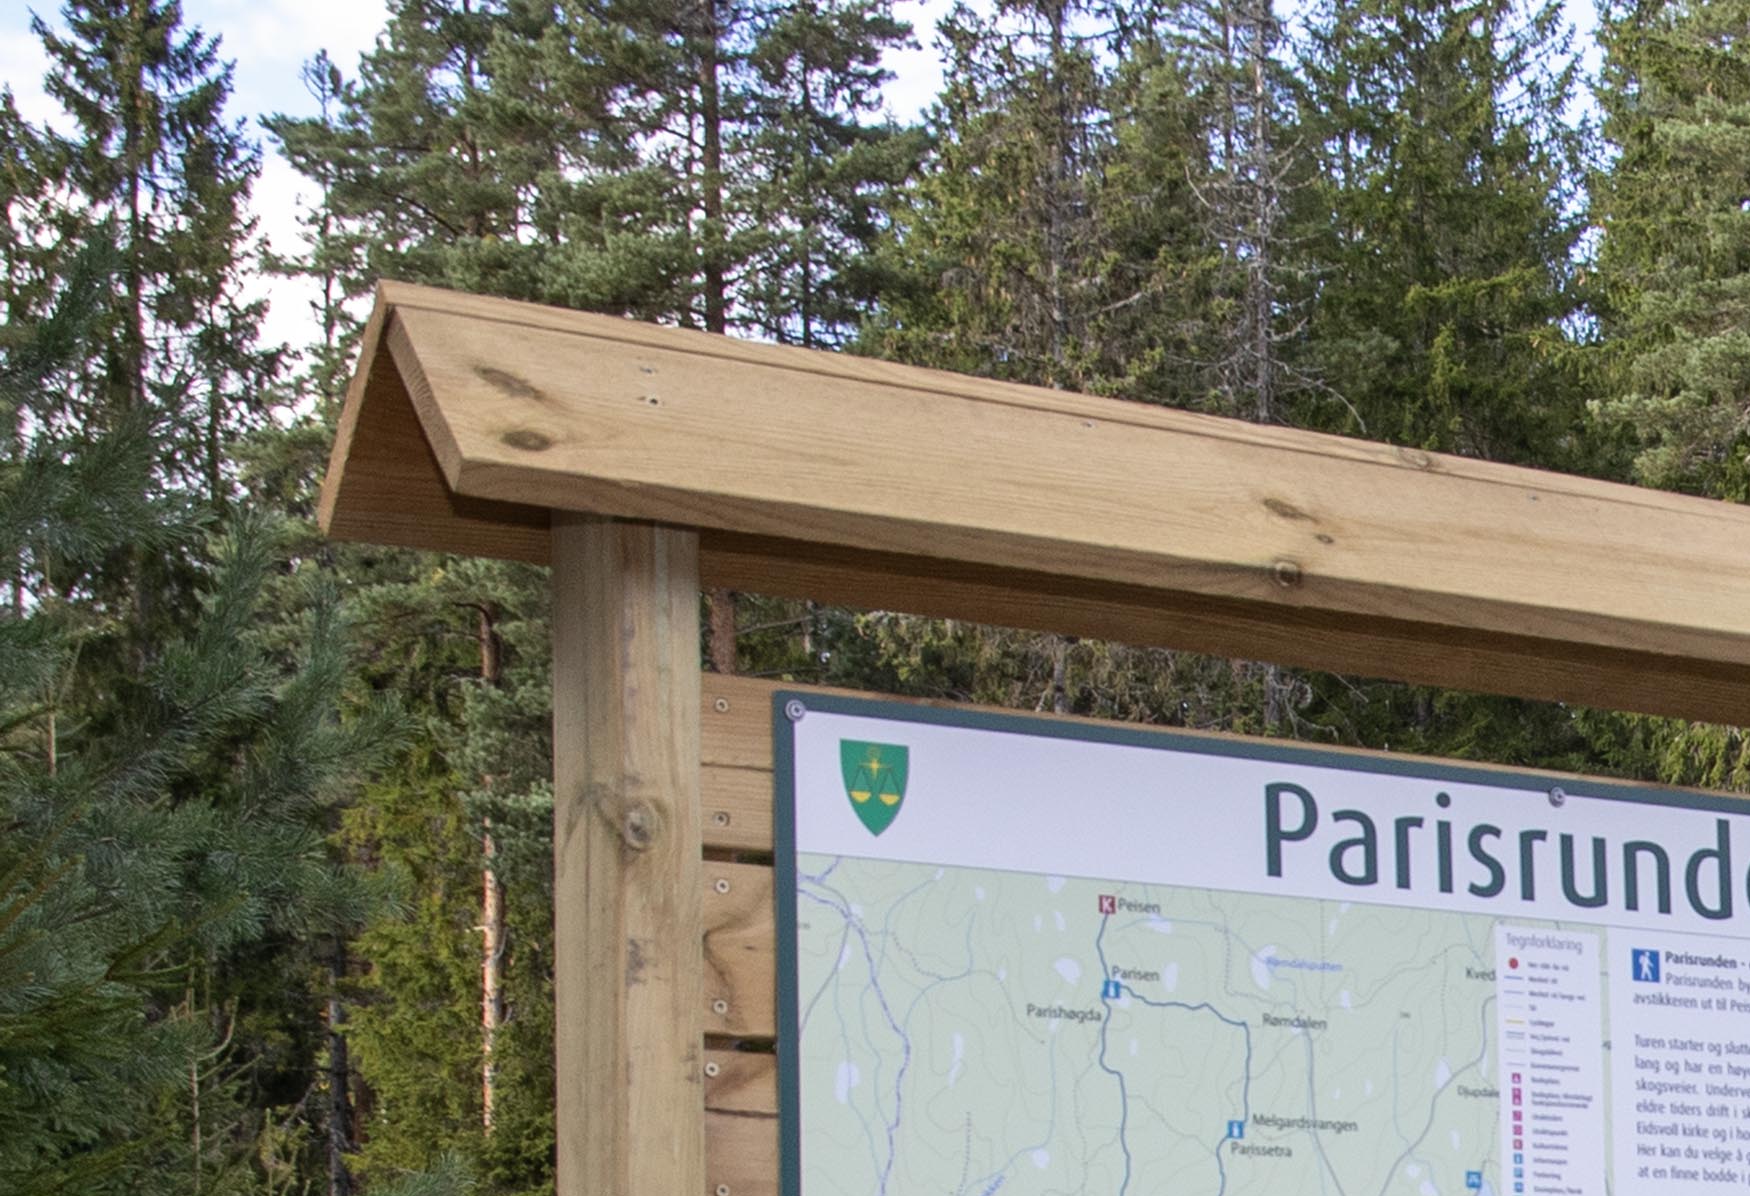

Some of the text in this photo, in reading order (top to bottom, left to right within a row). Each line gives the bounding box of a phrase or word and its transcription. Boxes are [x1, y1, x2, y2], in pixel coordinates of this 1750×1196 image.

[1118, 898, 1160, 914] Peisen
[1507, 933, 1583, 954] Tegnforklaring
[1665, 951, 1737, 969] Parisrunden
[1112, 966, 1159, 982] Parisen
[1666, 972, 1733, 989] Parisrunden
[1633, 992, 1697, 1009] avstikkeren
[1700, 998, 1712, 1010] ut
[1715, 998, 1726, 1011] til
[1027, 1004, 1101, 1024] Parishøgda
[1262, 1012, 1327, 1030] Rømdalen
[1635, 1035, 1665, 1049] Turen
[1668, 1039, 1704, 1052] starter
[1707, 1043, 1721, 1056] og
[1635, 1079, 1697, 1097] skogsveier.
[1252, 1113, 1358, 1133] Melgardsvangen
[1231, 1141, 1292, 1158] Parissetra
